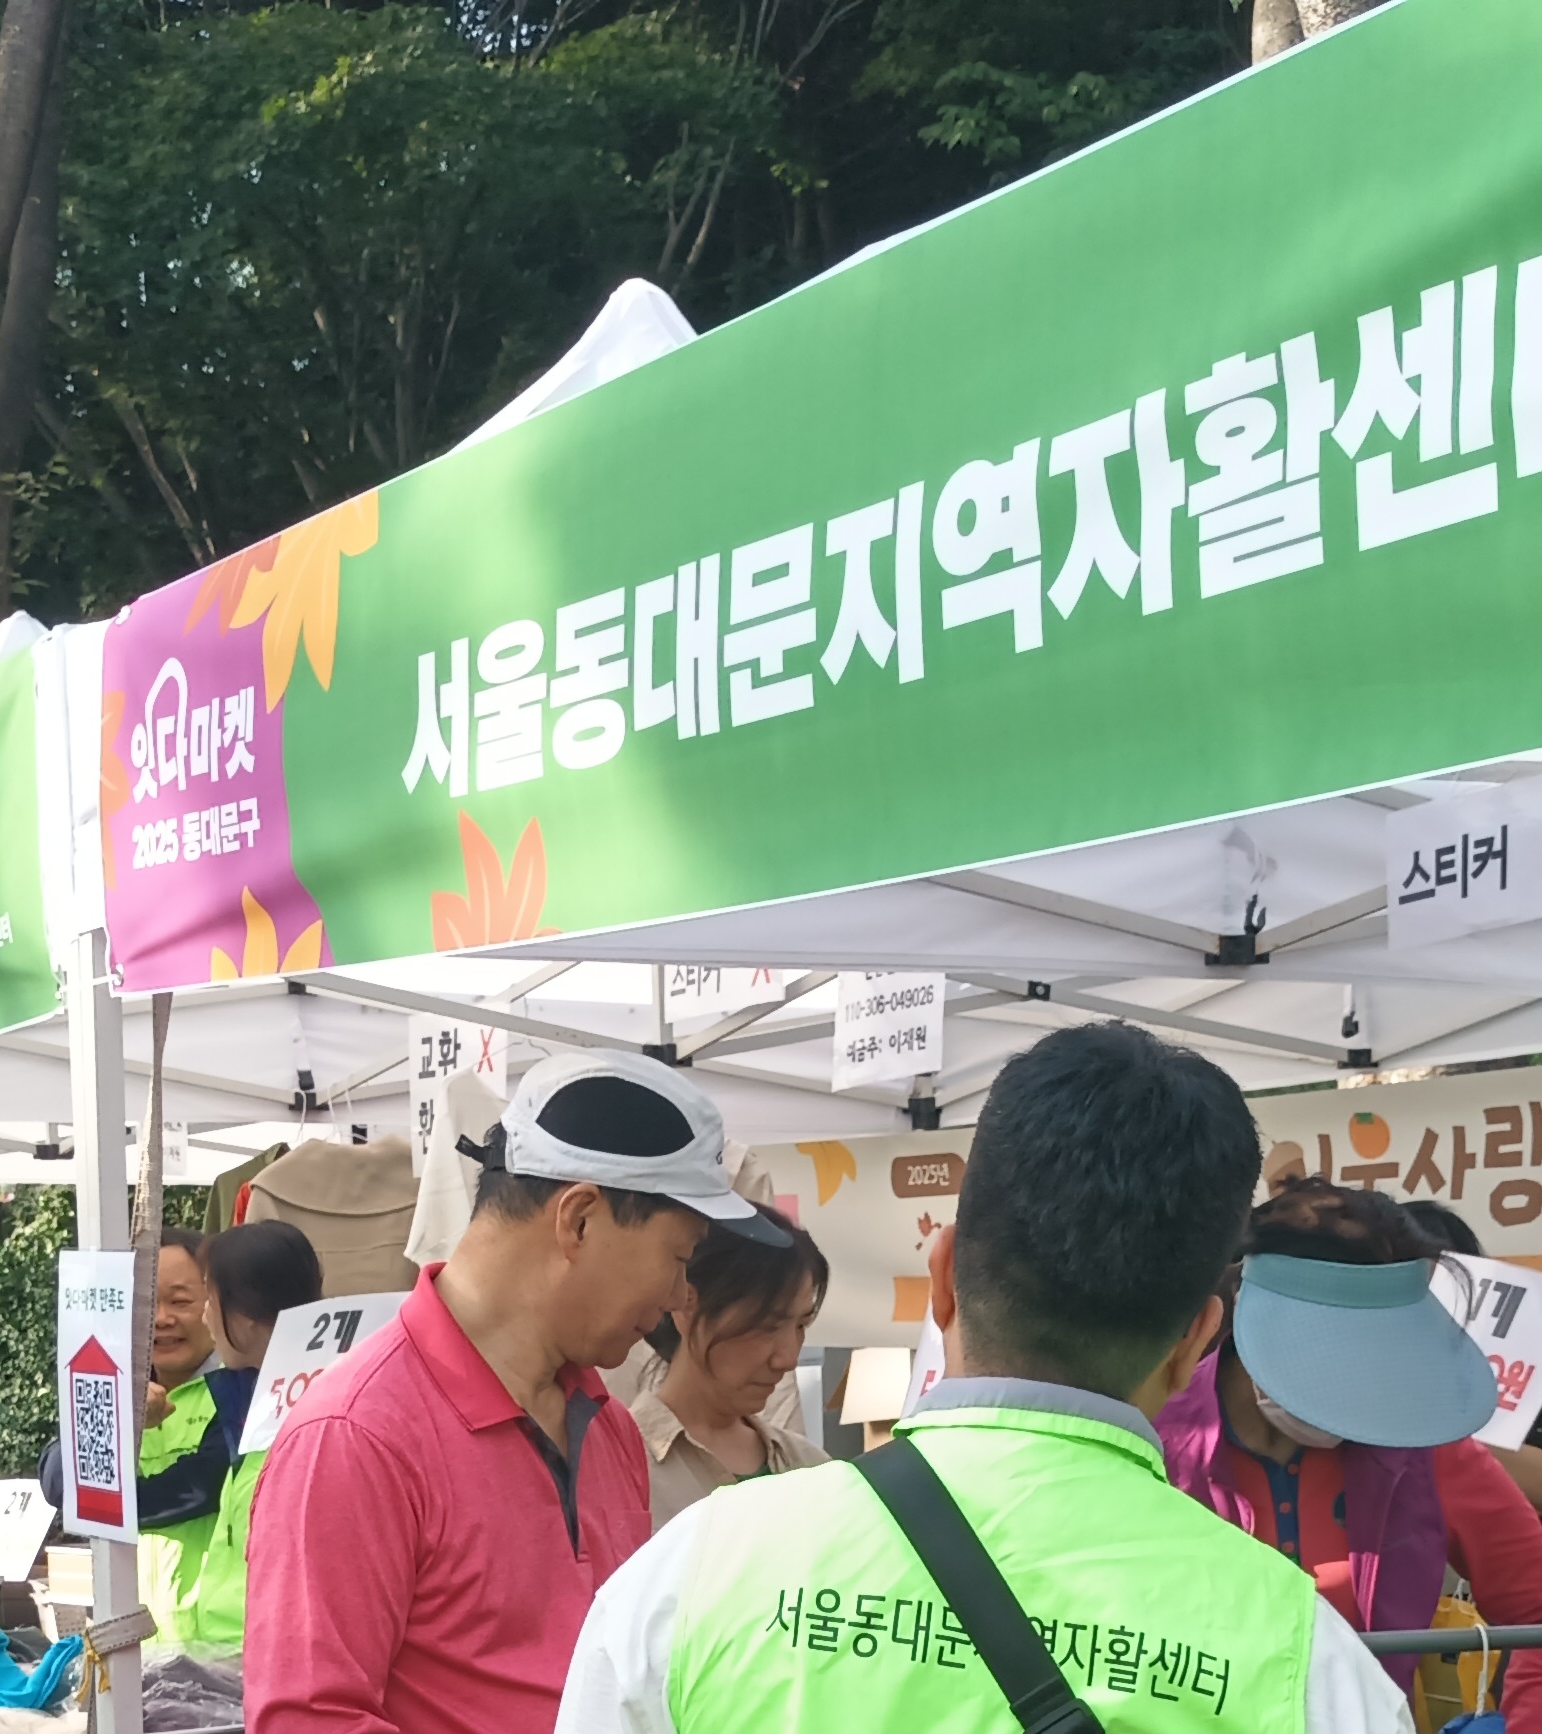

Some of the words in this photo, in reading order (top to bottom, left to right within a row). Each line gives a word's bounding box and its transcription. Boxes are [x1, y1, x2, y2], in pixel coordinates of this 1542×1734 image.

[131, 657, 256, 804] 잇다마켓
[132, 817, 179, 869] 2025
[182, 797, 261, 862] 동대문구
[1398, 825, 1509, 906] 스티커
[845, 984, 934, 1022] 110-306-049026
[906, 1162, 950, 1187] 2025년
[100, 1287, 125, 1313] 만족도
[305, 1310, 364, 1354] 2개
[765, 1587, 1231, 1716] 서울동대문역자활센터
